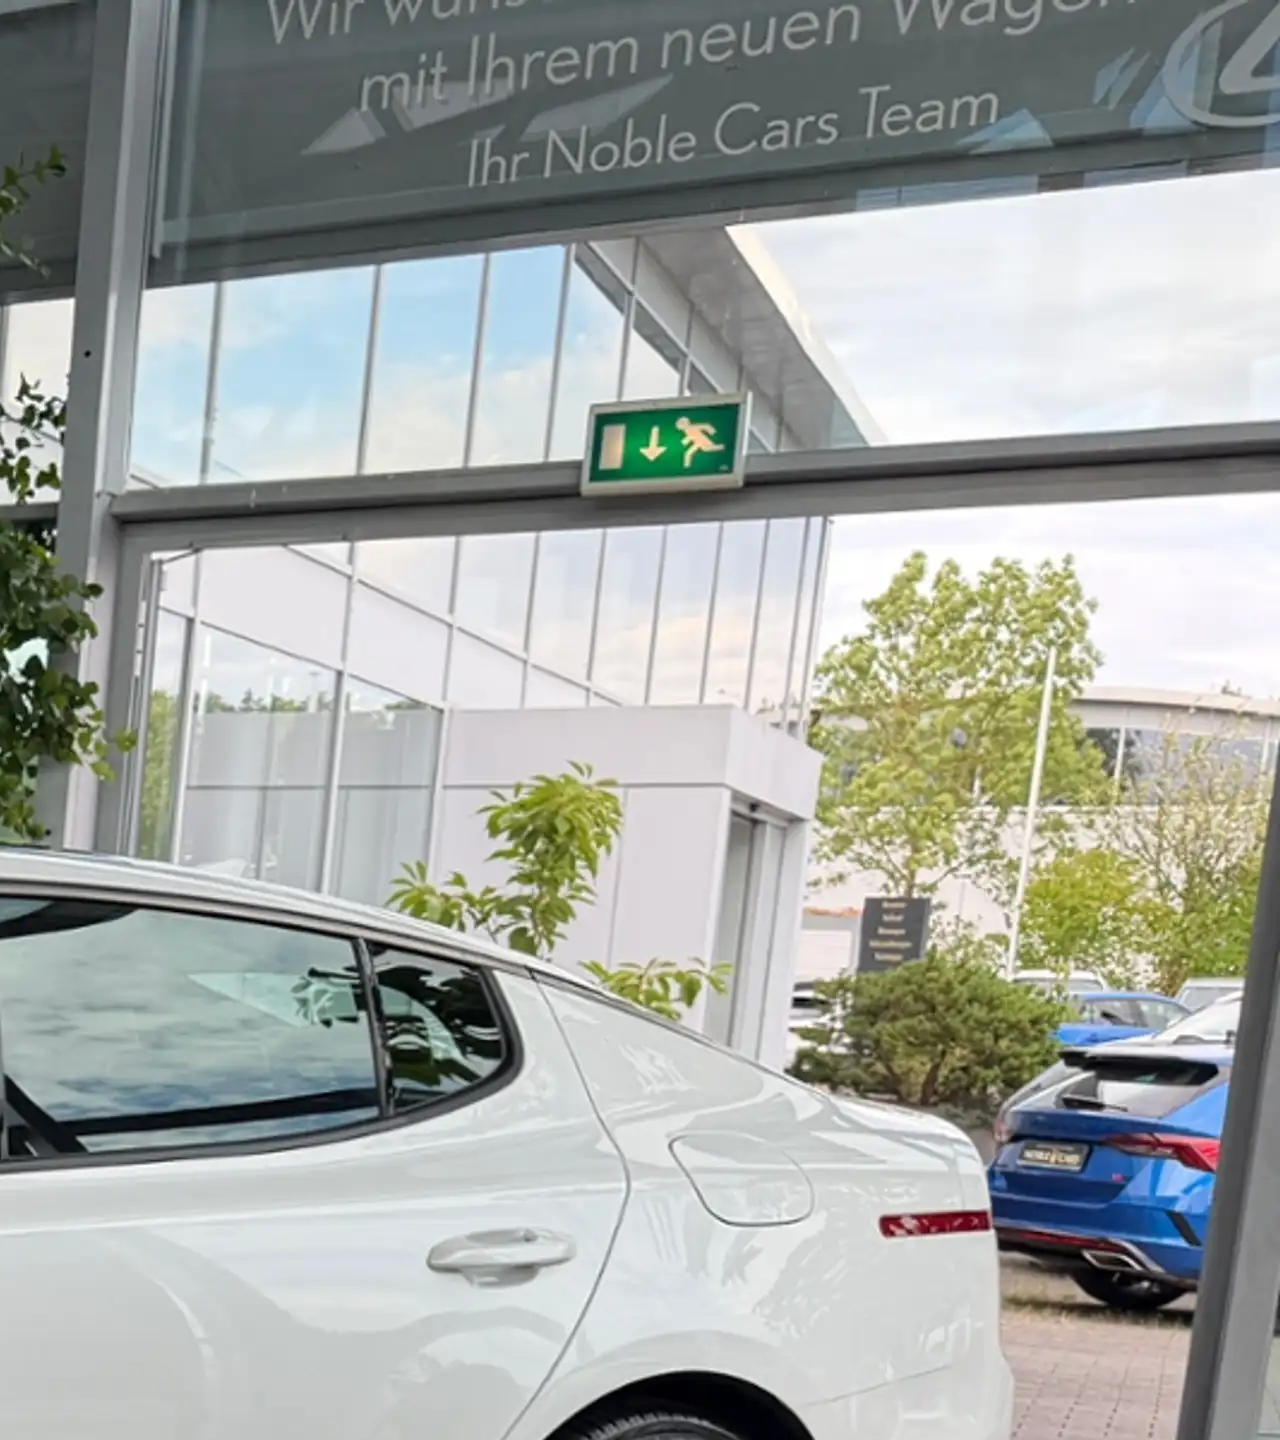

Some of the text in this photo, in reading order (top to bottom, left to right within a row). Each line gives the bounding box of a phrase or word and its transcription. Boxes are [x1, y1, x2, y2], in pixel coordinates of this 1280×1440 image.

[268, 0, 364, 44] Wir
[360, 0, 1138, 112] mit Ihrem neuen Wag
[468, 85, 999, 188] Ihr Noble Cars Team
